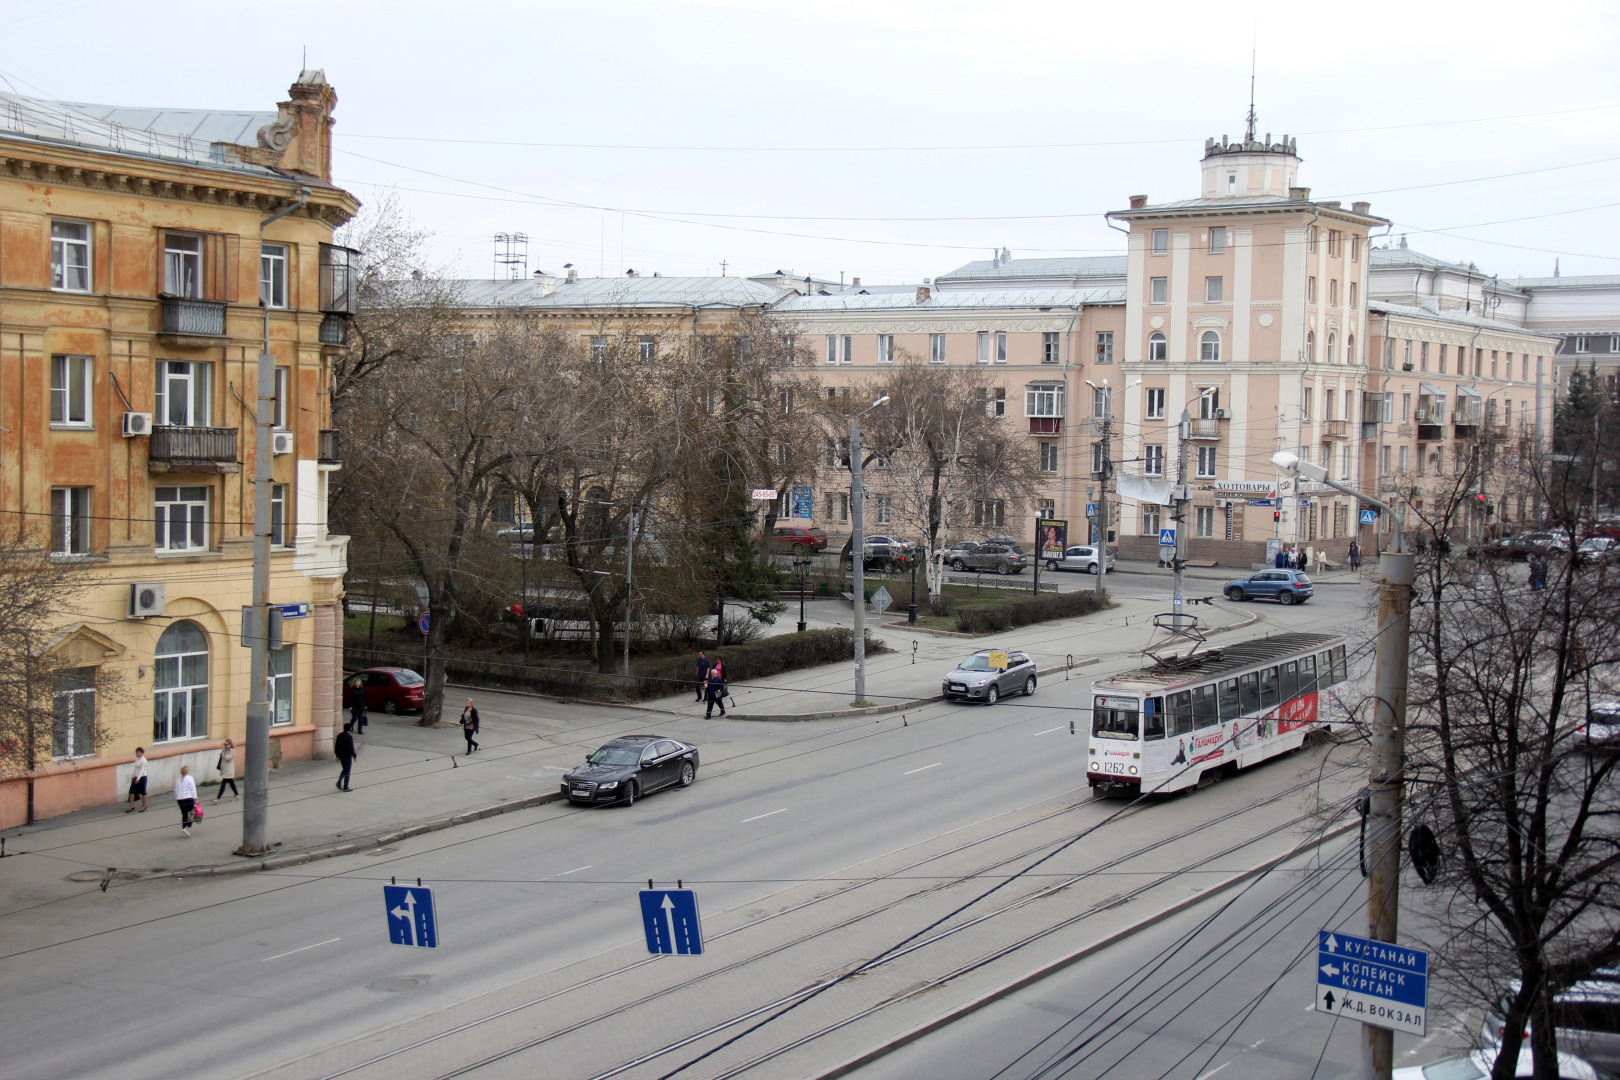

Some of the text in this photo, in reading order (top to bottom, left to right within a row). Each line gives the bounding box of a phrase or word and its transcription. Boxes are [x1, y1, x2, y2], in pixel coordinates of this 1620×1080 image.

[1217, 483, 1270, 491] ХОЗТОВАРЫ
[1100, 698, 1107, 706] 7
[1195, 734, 1223, 750] Галамарт
[1104, 762, 1125, 774] 1262
[1345, 941, 1416, 967] КУСТАНАЙ
[1342, 961, 1405, 985] КОПЕЙСК
[1342, 975, 1393, 996] КУРГАН
